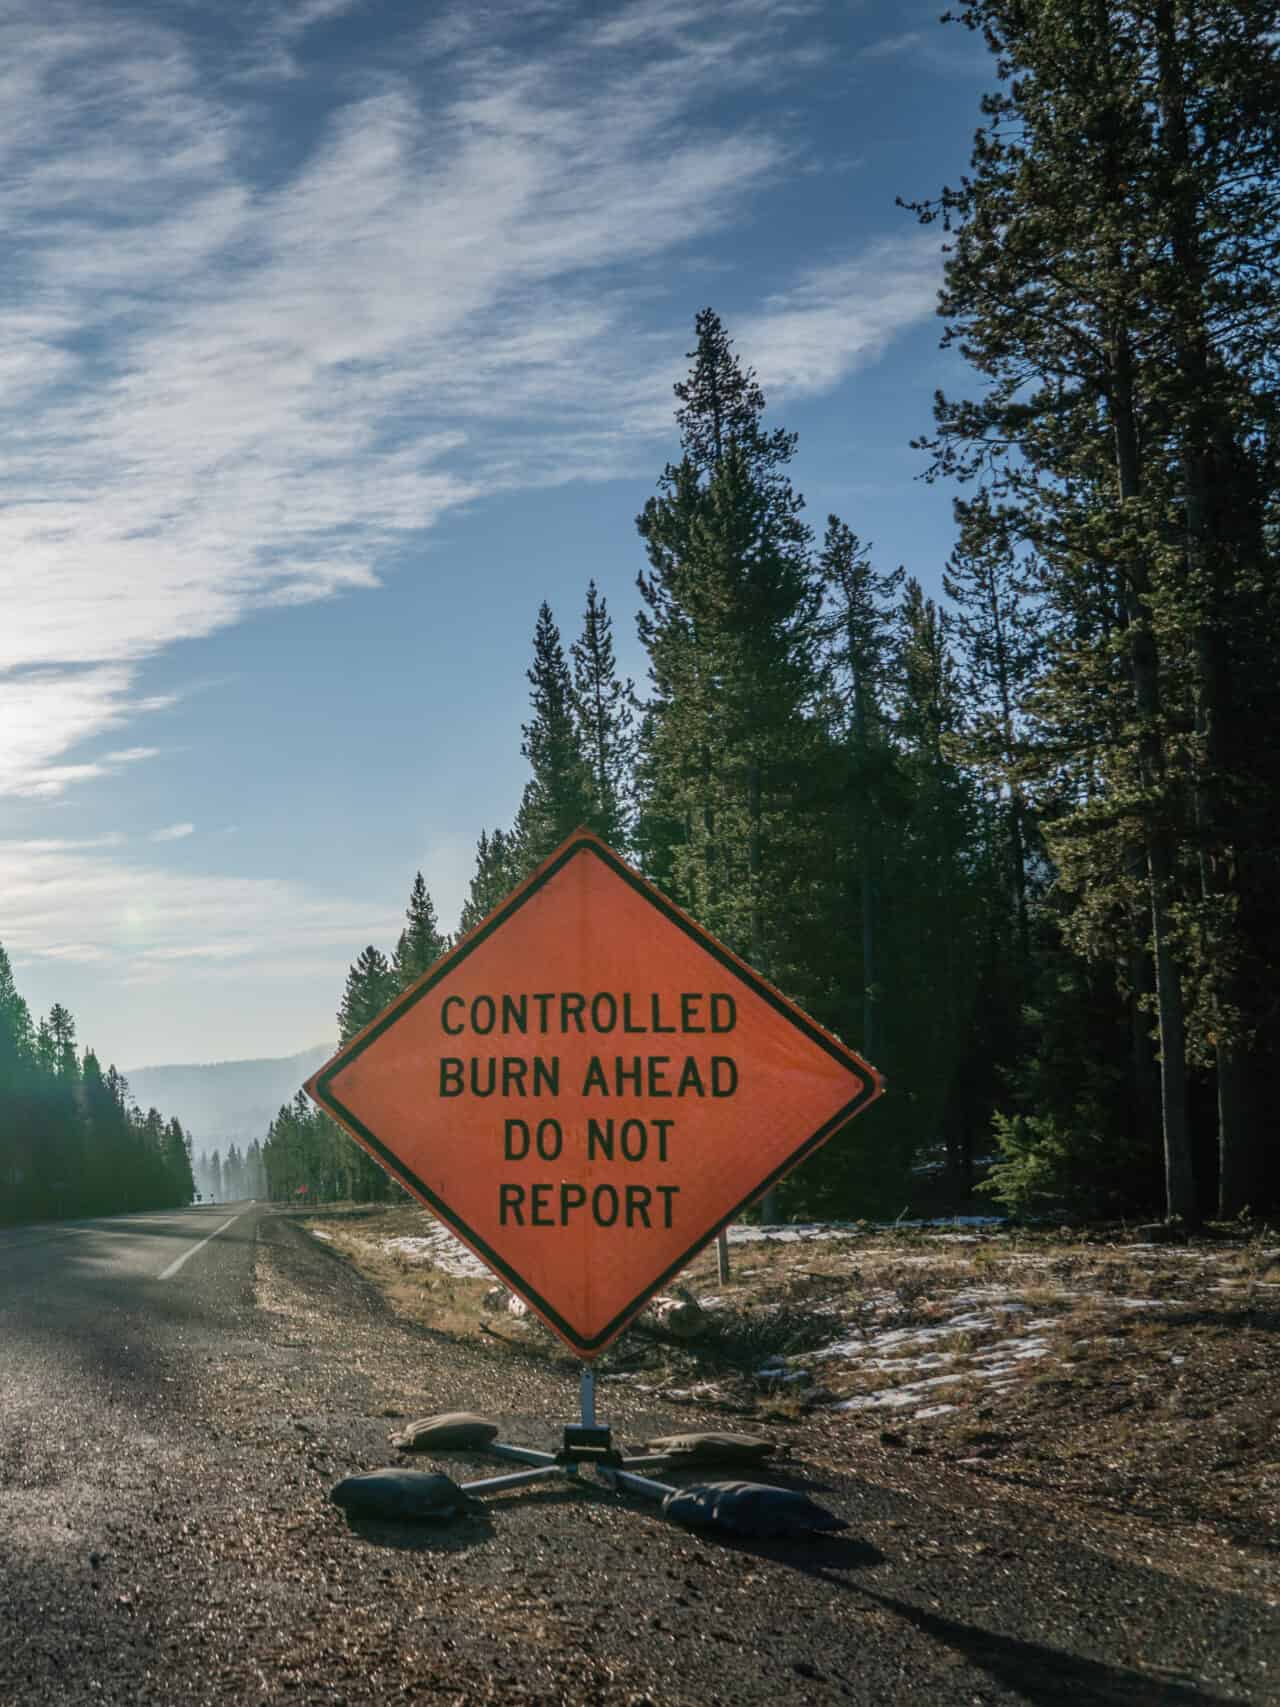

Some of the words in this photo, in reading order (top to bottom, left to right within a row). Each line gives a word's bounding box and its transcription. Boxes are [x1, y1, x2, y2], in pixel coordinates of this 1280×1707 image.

[440, 993, 738, 1035] CONTROLLED
[438, 1056, 559, 1098] BURN
[582, 1056, 739, 1098] AHEAD
[504, 1119, 563, 1162] DO
[587, 1119, 675, 1163] NOT
[499, 1184, 681, 1230] REPORT
